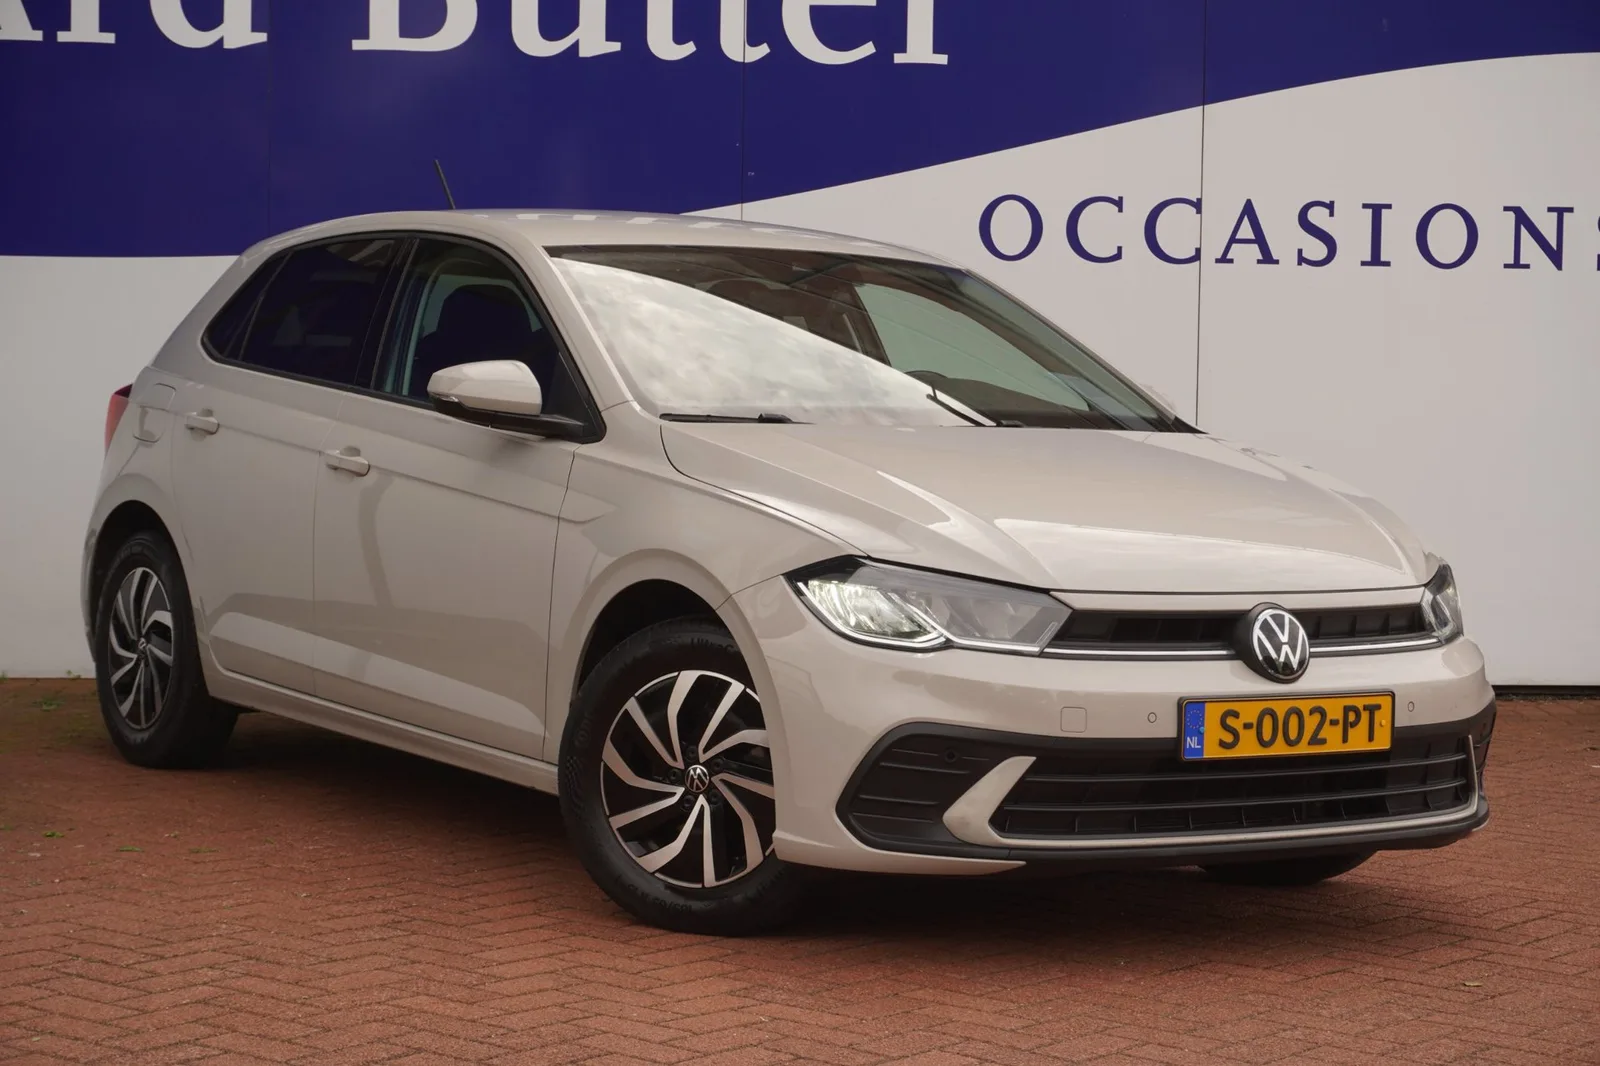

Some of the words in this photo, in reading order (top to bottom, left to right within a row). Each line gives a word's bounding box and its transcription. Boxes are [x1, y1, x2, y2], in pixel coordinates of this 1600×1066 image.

[978, 194, 1600, 272] OCCASION
[1186, 736, 1201, 749] NL
[1218, 703, 1382, 750] S-002-PT
